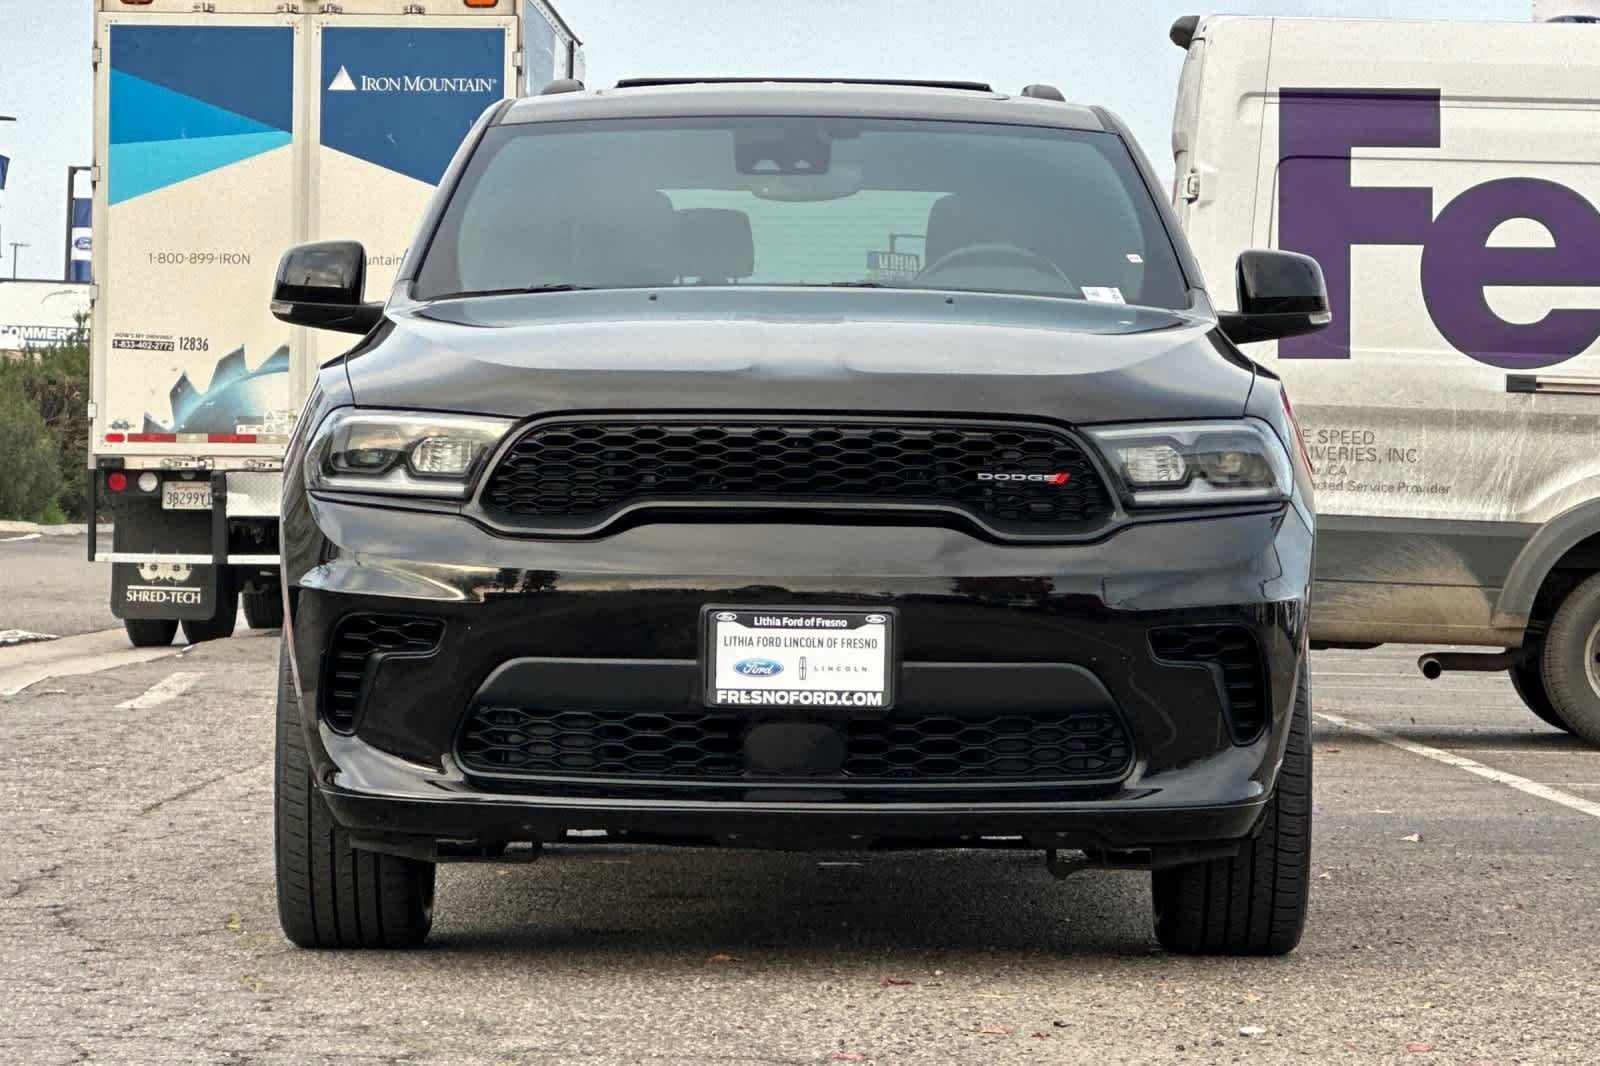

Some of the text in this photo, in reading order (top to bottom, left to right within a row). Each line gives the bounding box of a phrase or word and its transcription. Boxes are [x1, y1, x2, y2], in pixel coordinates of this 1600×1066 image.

[361, 75, 493, 92] IRON MOUNTAIN
[148, 252, 251, 265] 1-800-899-IRON
[179, 336, 209, 351] 12836
[1318, 429, 1375, 445] SPEED
[1388, 448, 1418, 463] INC
[977, 472, 1058, 482] DODGE
[1328, 464, 1348, 476] CA
[1346, 480, 1395, 493] Service
[1397, 482, 1451, 494] Provider
[126, 590, 201, 604] SHRED-TECH
[754, 616, 848, 628] Lithia Ford of Fresno
[723, 636, 878, 649] LITHIA FORD LINCOLN OF FRESNO
[814, 665, 868, 673] LINCOLN
[716, 690, 882, 706] FRESNOFORD.COM
